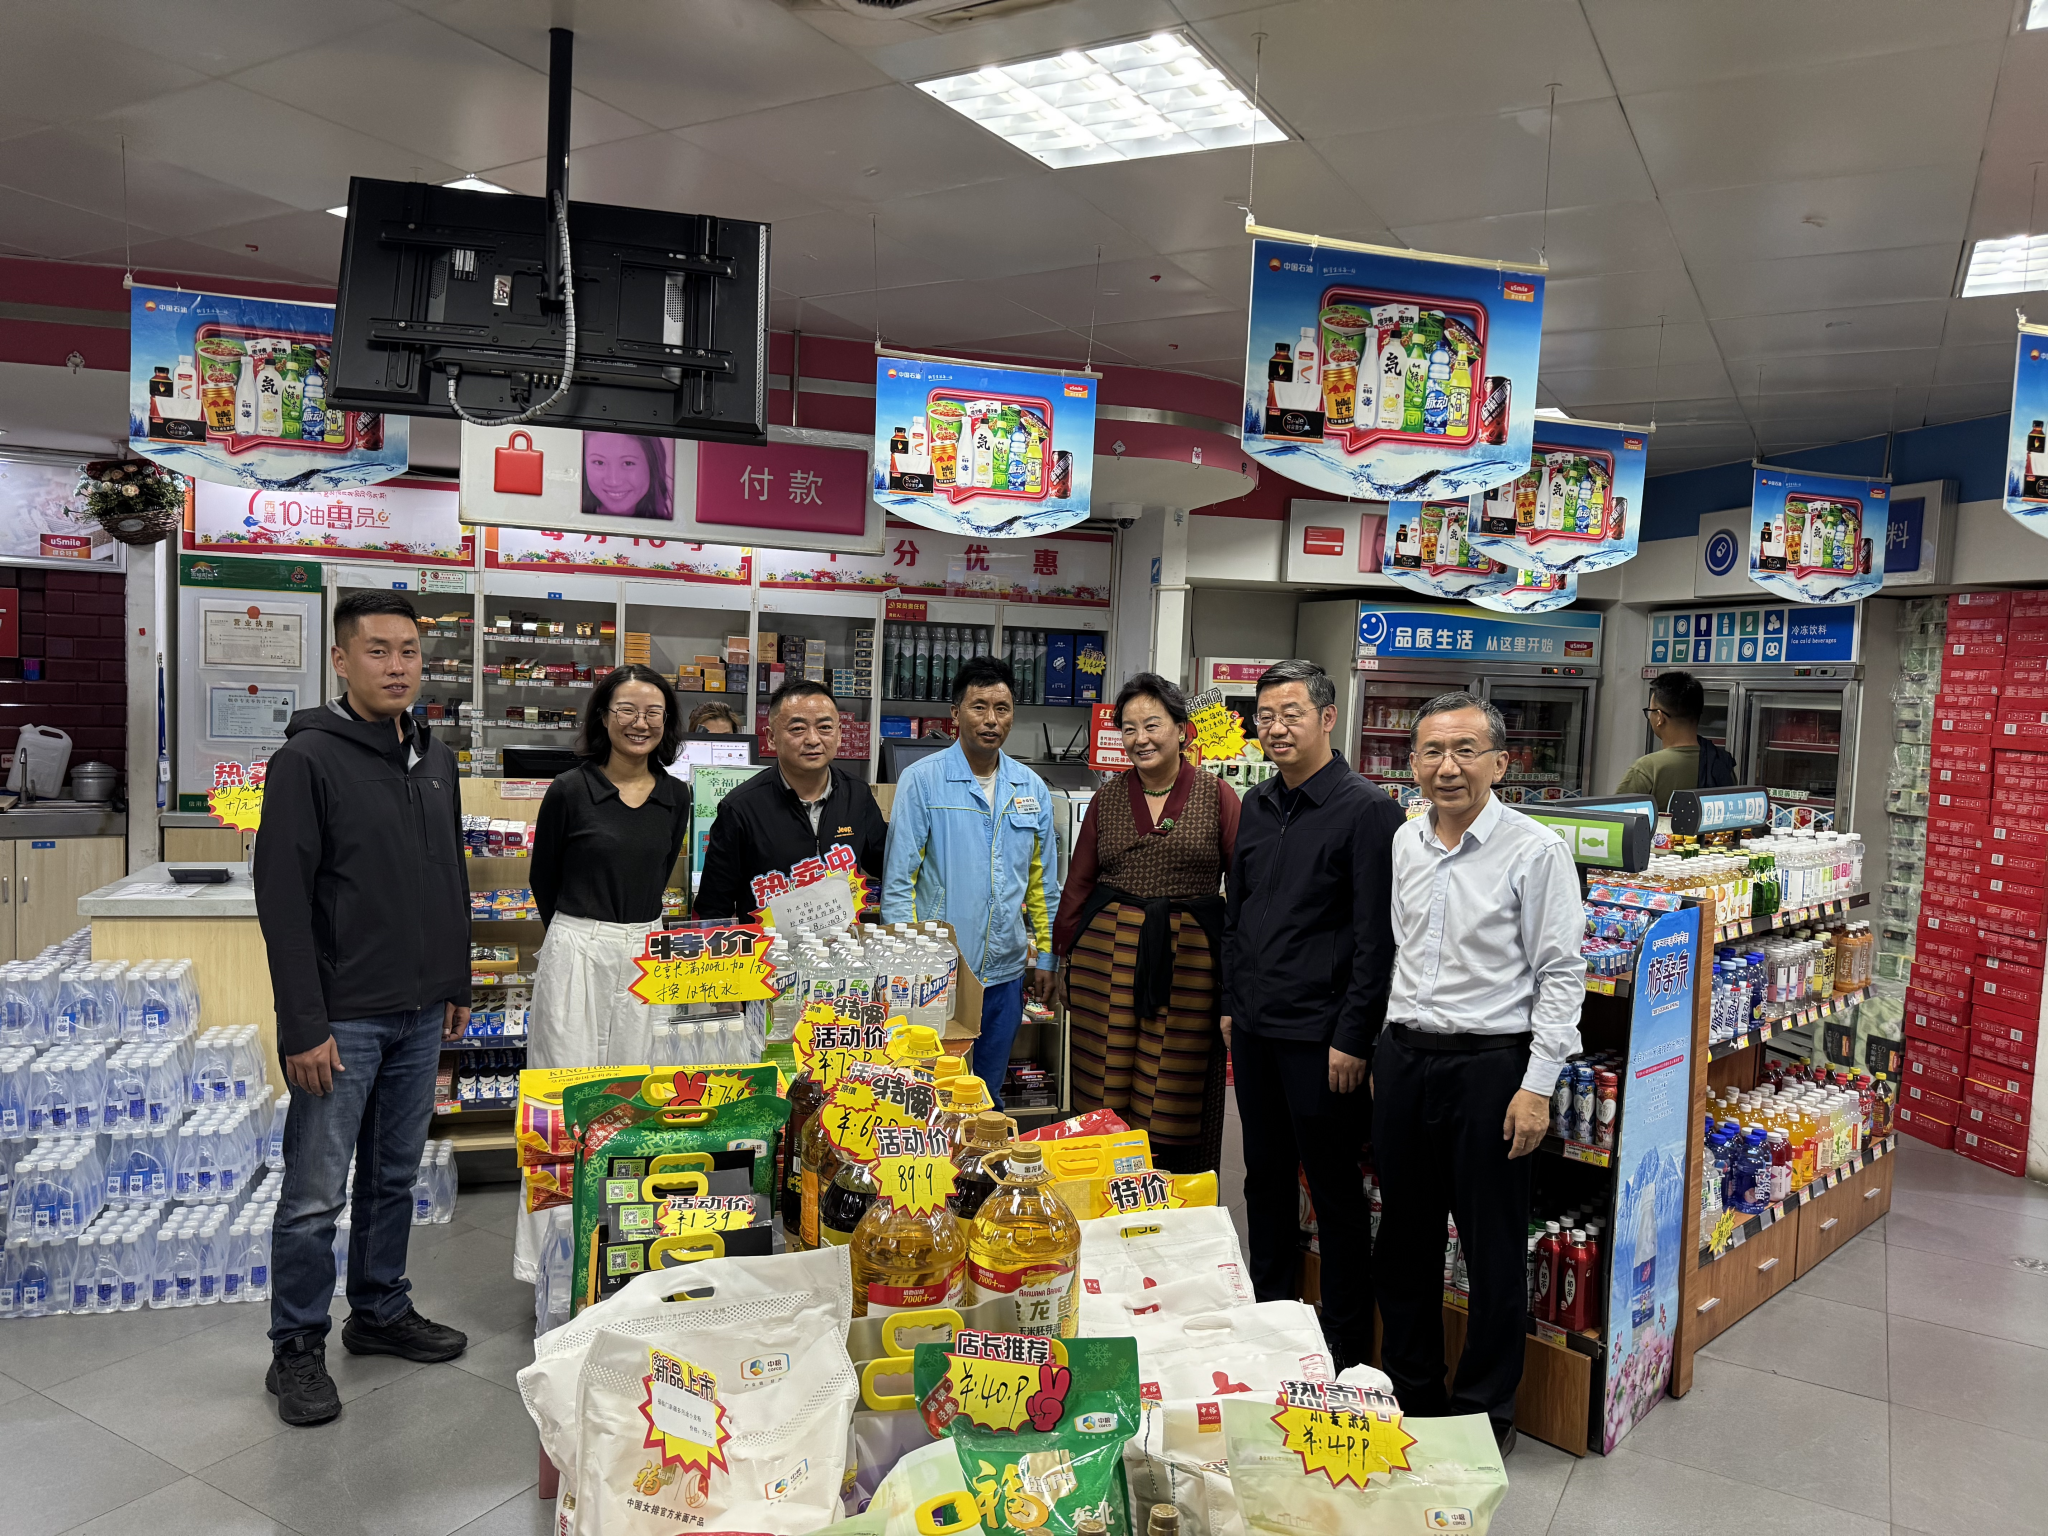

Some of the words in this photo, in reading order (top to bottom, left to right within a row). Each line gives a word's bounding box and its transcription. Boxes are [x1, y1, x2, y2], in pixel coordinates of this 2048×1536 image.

[1284, 262, 1314, 273] 中国石油
[159, 304, 188, 314] 中国石油
[898, 371, 921, 379] 中国石油
[1336, 407, 1352, 415] 红牛
[1425, 396, 1448, 411] 脉动
[740, 465, 823, 506] 付款
[264, 500, 276, 524] 西藏
[50, 536, 81, 547] uSmile
[1886, 520, 1909, 550] 料
[896, 602, 926, 610] 党员责任区
[233, 618, 274, 629] 营业执照
[1791, 624, 1828, 636] 冷冻饮料
[1394, 627, 1474, 650] 品质生活
[1486, 635, 1554, 653] 从这里开始
[1812, 637, 1837, 645] beverages
[1383, 770, 1415, 778] 更多清爽
[837, 826, 852, 834] Jeep
[752, 846, 855, 907] 热卖中
[650, 930, 760, 962] 特价
[1645, 950, 1689, 1004] 格桑泉
[814, 1026, 886, 1049] 活动价
[549, 1068, 582, 1077] KING
[878, 1127, 949, 1156] 活动价
[897, 1163, 934, 1204] 89.9
[1110, 1172, 1169, 1211] 特价
[669, 1197, 751, 1211] 活动价
[956, 1332, 1050, 1365] 店长推荐
[767, 1359, 782, 1367] 中粮
[651, 1352, 716, 1402] 新品上市
[1286, 1381, 1398, 1420] 热卖中
[1200, 1405, 1218, 1415] 中裕
[1098, 1416, 1111, 1424] 中粮
[1309, 1409, 1371, 1433] 小麦粉
[633, 1459, 662, 1496] 福
[626, 1497, 706, 1528] 中国女排官方米面产品
[1451, 1513, 1466, 1521] 中粮
